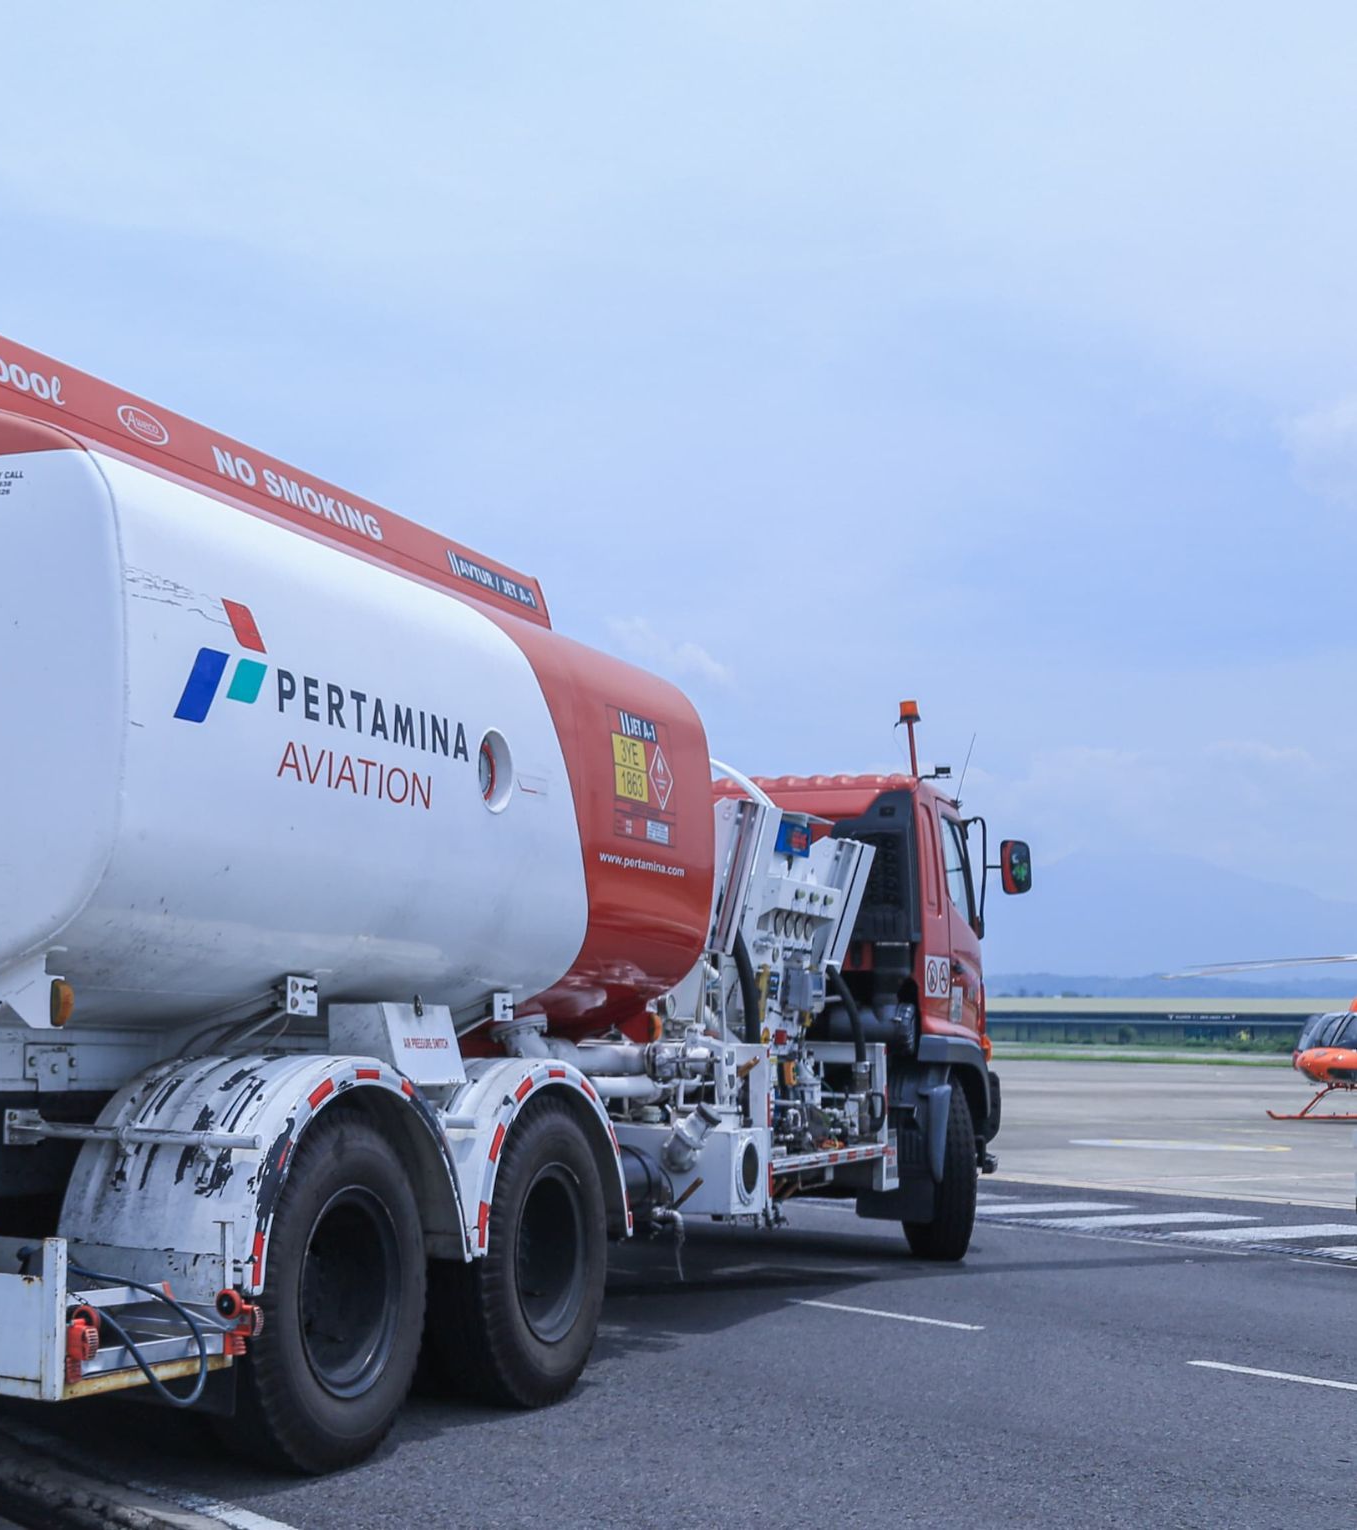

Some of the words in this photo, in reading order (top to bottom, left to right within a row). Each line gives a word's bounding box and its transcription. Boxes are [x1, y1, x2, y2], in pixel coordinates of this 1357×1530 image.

[4, 470, 24, 479] CALL
[211, 445, 257, 487] NO
[262, 468, 384, 541] SMOKING
[459, 560, 495, 589] AVTUR
[502, 578, 518, 599] JET
[519, 587, 536, 607] A-1
[276, 667, 470, 763] PERTAMINA
[629, 715, 642, 737] JET
[643, 719, 656, 742] A-1
[620, 739, 640, 766] 3YE
[276, 740, 433, 811] AVIATION
[621, 769, 643, 798] 1863
[599, 851, 685, 877] www.pertamina.com
